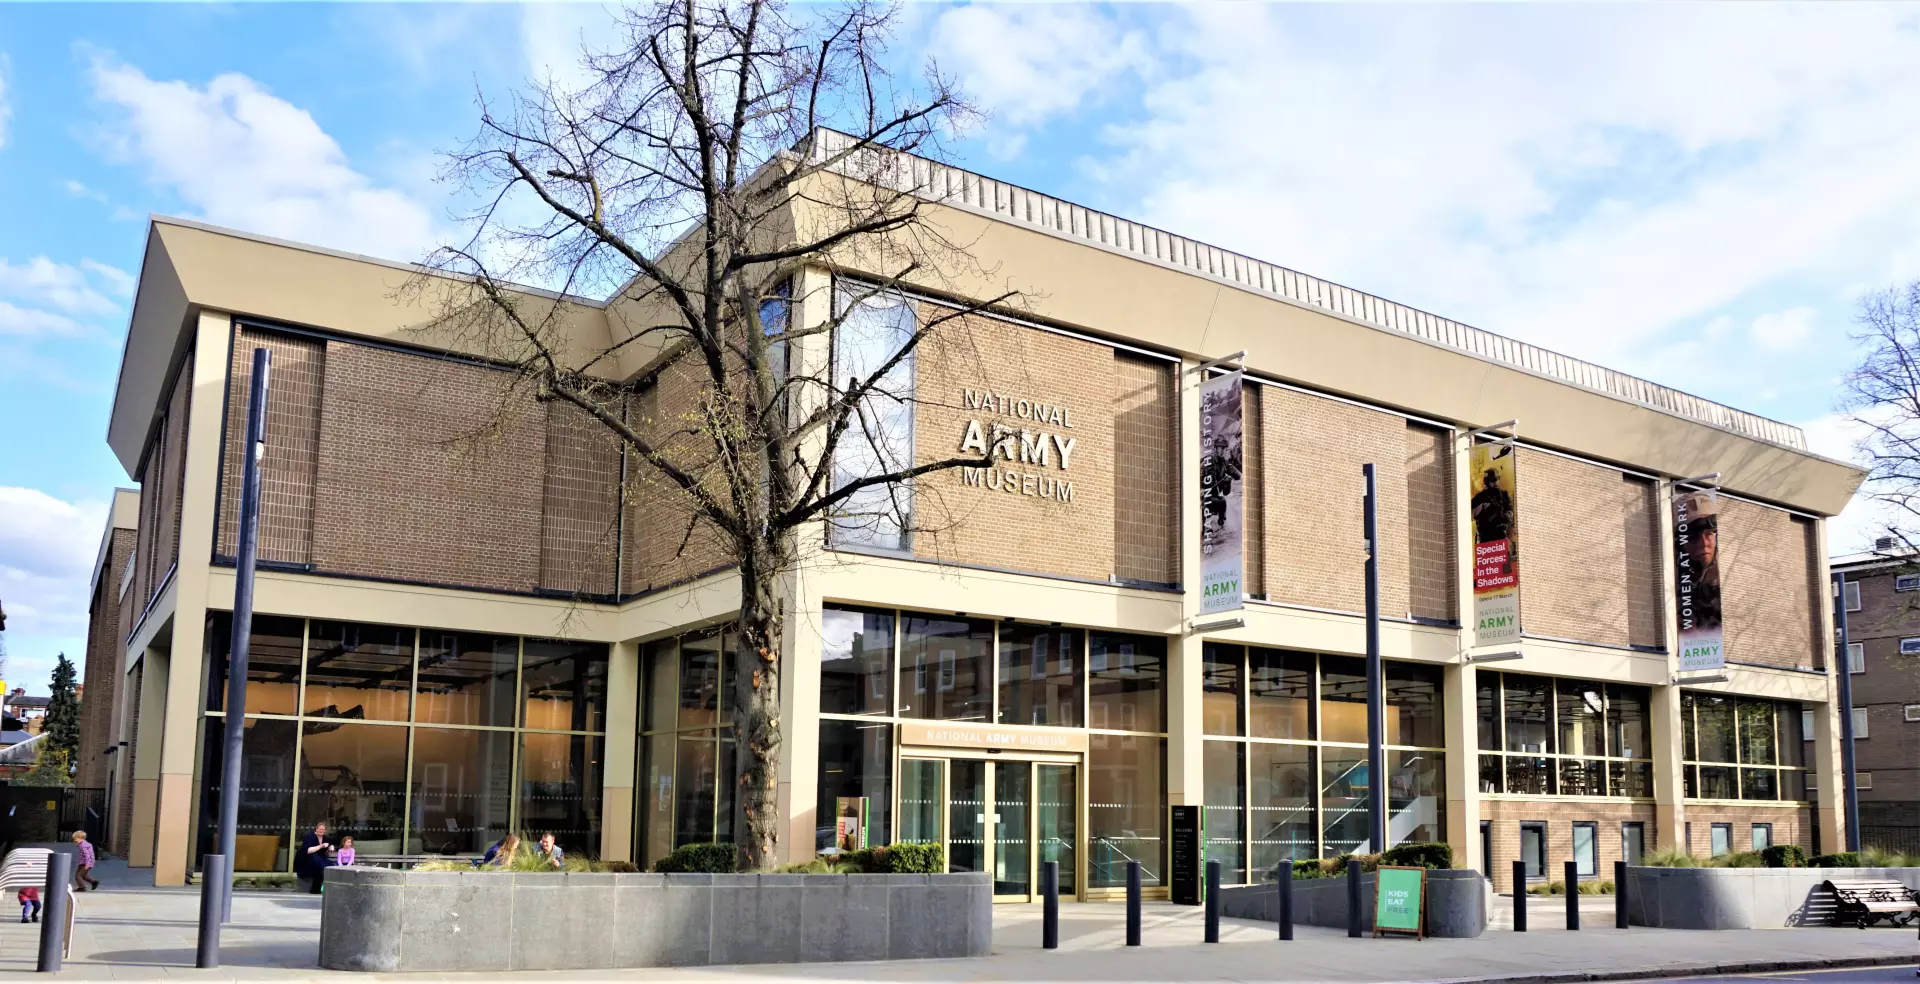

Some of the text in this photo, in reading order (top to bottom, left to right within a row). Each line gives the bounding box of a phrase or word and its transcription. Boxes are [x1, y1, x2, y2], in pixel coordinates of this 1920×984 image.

[963, 388, 1074, 428] NATIONAL
[961, 419, 1077, 470] ARMY
[1203, 392, 1213, 553] SHAPING HISTORY
[963, 466, 1073, 502] MUSEUM
[1476, 542, 1506, 556] Special
[1477, 555, 1507, 566] Forces:
[1678, 503, 1693, 630] WOMEN AT WORK
[1204, 569, 1238, 581] NATIONAL
[1477, 566, 1499, 577] In the
[1204, 579, 1238, 597] ARMY
[1477, 575, 1514, 588] Shadows
[1204, 595, 1238, 608] MUSEUM
[1479, 606, 1514, 617] NATIONAL
[1479, 615, 1515, 629] ARMY
[1479, 628, 1515, 640] MUSEUM
[1684, 646, 1719, 658] ARMY
[1684, 657, 1719, 667] MUSEUM
[927, 731, 1067, 745] NATIONAL ARMY MUSEUM
[1387, 890, 1409, 898] KIDS
[1387, 898, 1405, 906] EAT
